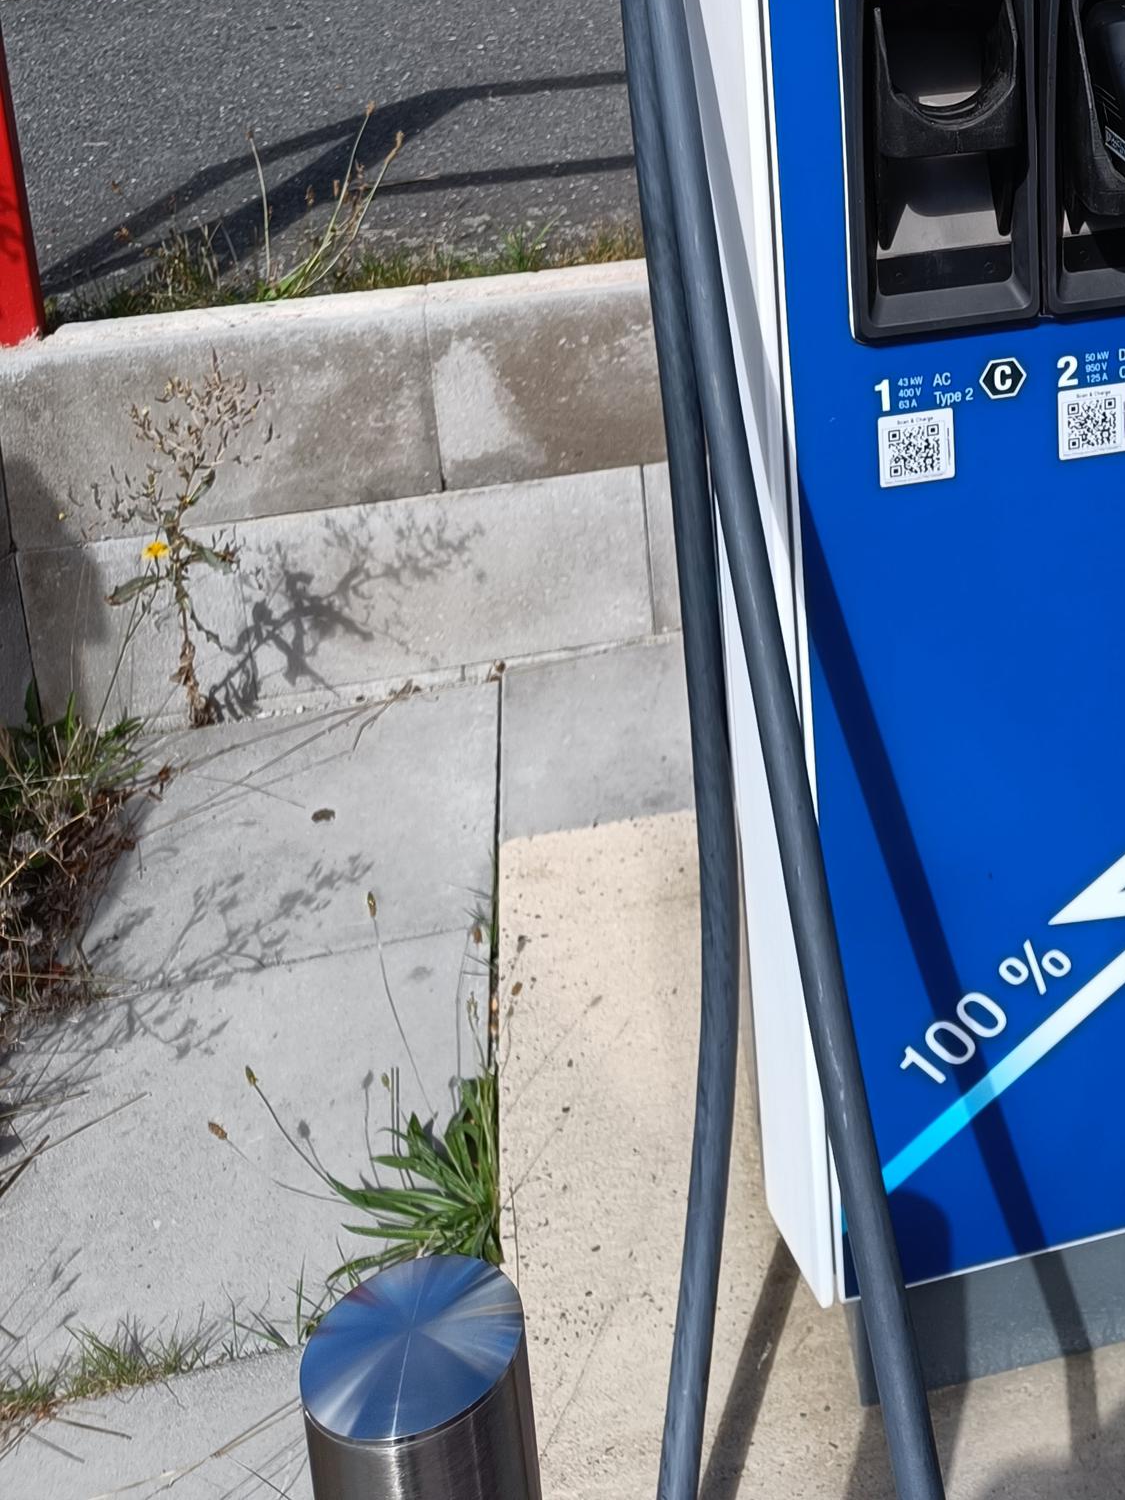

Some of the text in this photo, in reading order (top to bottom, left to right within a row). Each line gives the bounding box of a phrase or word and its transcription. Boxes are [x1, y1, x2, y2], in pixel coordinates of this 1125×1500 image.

[1085, 351, 1109, 362] 50 kW
[1057, 355, 1078, 388] 2
[1085, 362, 1107, 373] 950 V
[898, 376, 923, 387] 43 kW
[933, 372, 951, 387] AC
[993, 365, 1012, 391] C
[1086, 373, 1108, 383] 125 A
[874, 379, 891, 412] 1
[898, 388, 921, 398] 400 V
[934, 388, 974, 406] Type 2
[899, 399, 917, 409] 63 A
[900, 938, 1072, 1084] 100 %
